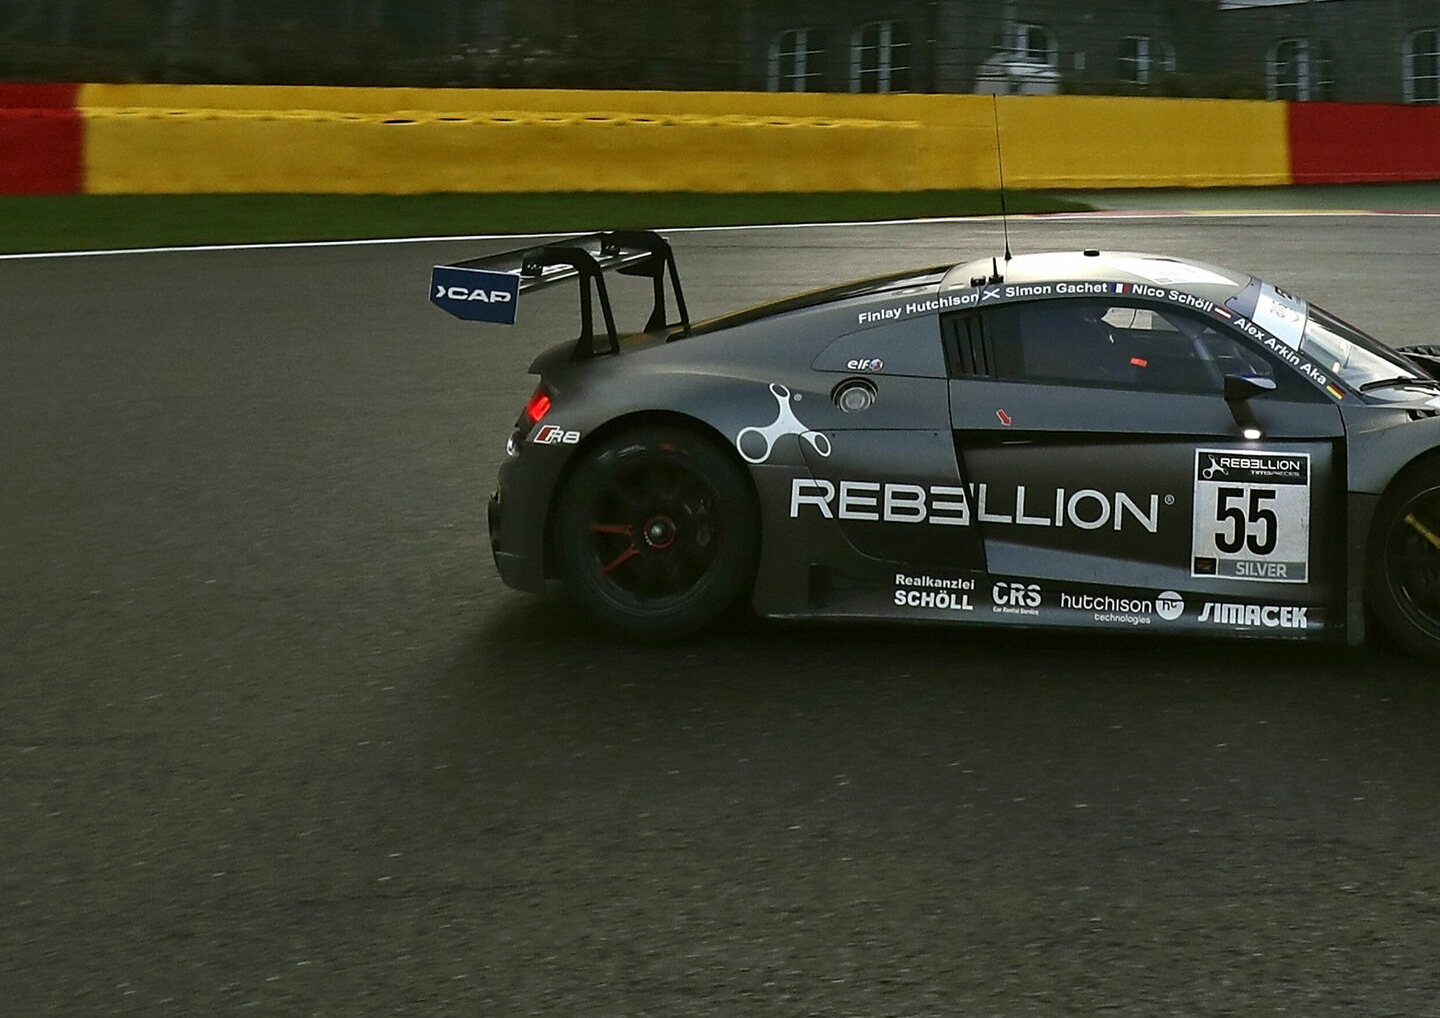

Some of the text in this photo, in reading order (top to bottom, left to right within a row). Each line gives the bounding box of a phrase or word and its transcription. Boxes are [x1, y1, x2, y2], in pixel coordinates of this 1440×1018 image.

[1005, 282, 1108, 297] Simon Gachet
[1132, 286, 1213, 312] Nico Schöll
[858, 293, 980, 324] Finlay Hutchison
[1233, 318, 1327, 385] Alex Arkin Aka
[847, 359, 870, 370] elf
[543, 428, 581, 444] R8
[1220, 457, 1300, 471] REBELLION
[1215, 486, 1278, 556] 55
[1236, 562, 1288, 578] SILVER
[895, 574, 975, 591] Realkanzlei
[894, 590, 974, 611] SCHÖLL
[992, 582, 1042, 608] CRS
[1061, 593, 1152, 614] hutchison
[1094, 613, 1151, 626] technologies
[1197, 602, 1308, 629] SIMACEK
